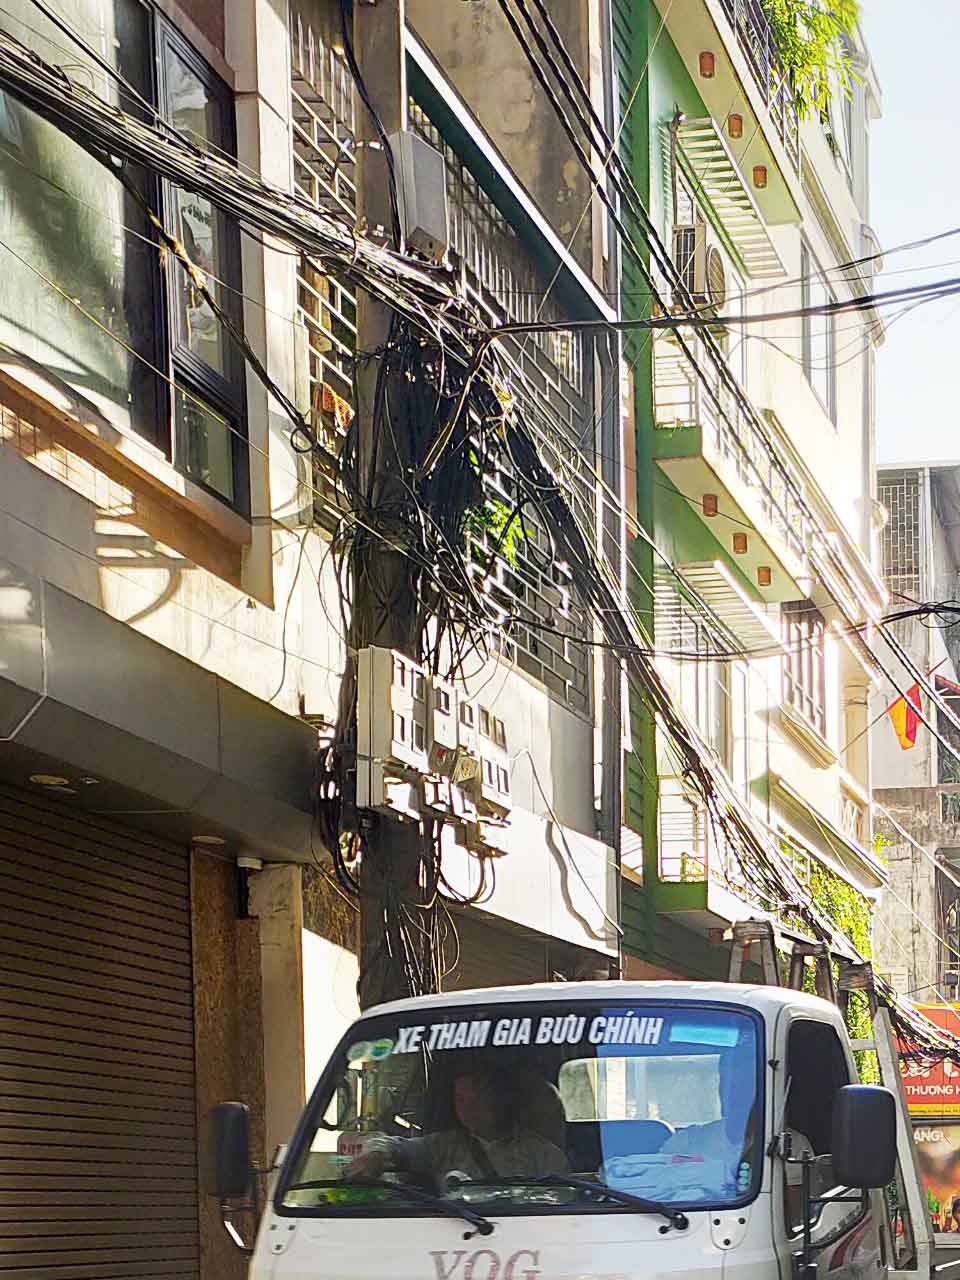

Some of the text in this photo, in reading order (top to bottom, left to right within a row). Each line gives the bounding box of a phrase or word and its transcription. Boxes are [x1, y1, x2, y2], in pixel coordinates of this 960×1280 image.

[392, 1026, 426, 1055] XE
[428, 1019, 491, 1051] THAM
[492, 1016, 534, 1046] GIA
[588, 1011, 664, 1045] CHÍNH
